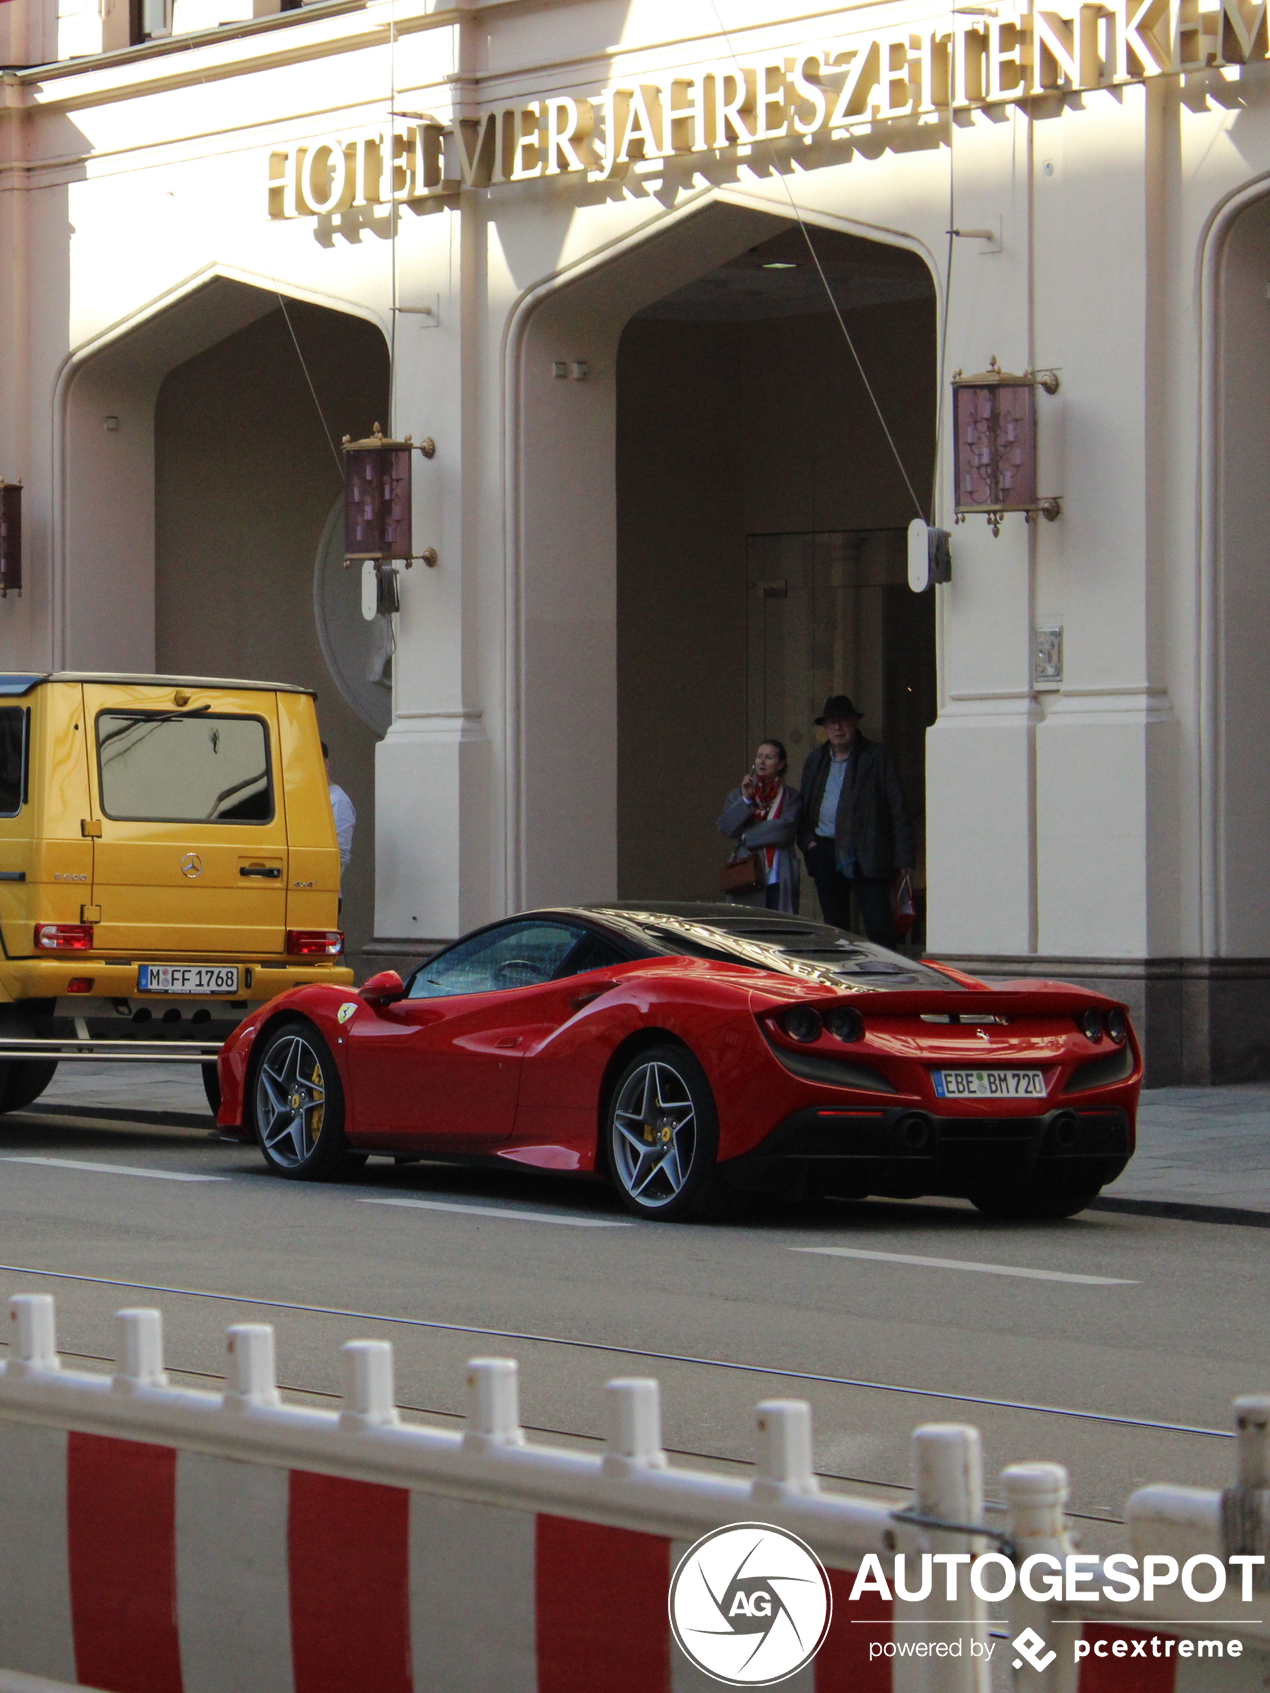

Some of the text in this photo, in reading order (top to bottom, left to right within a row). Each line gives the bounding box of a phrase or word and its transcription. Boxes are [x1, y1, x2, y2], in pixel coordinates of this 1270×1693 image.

[266, 121, 444, 219] HOTEL
[450, 96, 585, 188] VIER
[586, 6, 1087, 182] JAHRESZEITEN
[149, 969, 160, 986] M
[171, 969, 192, 986] FF
[195, 970, 234, 987] 1768
[944, 1073, 976, 1094] EBE
[987, 1073, 1010, 1094] BM
[1012, 1073, 1044, 1094] 720
